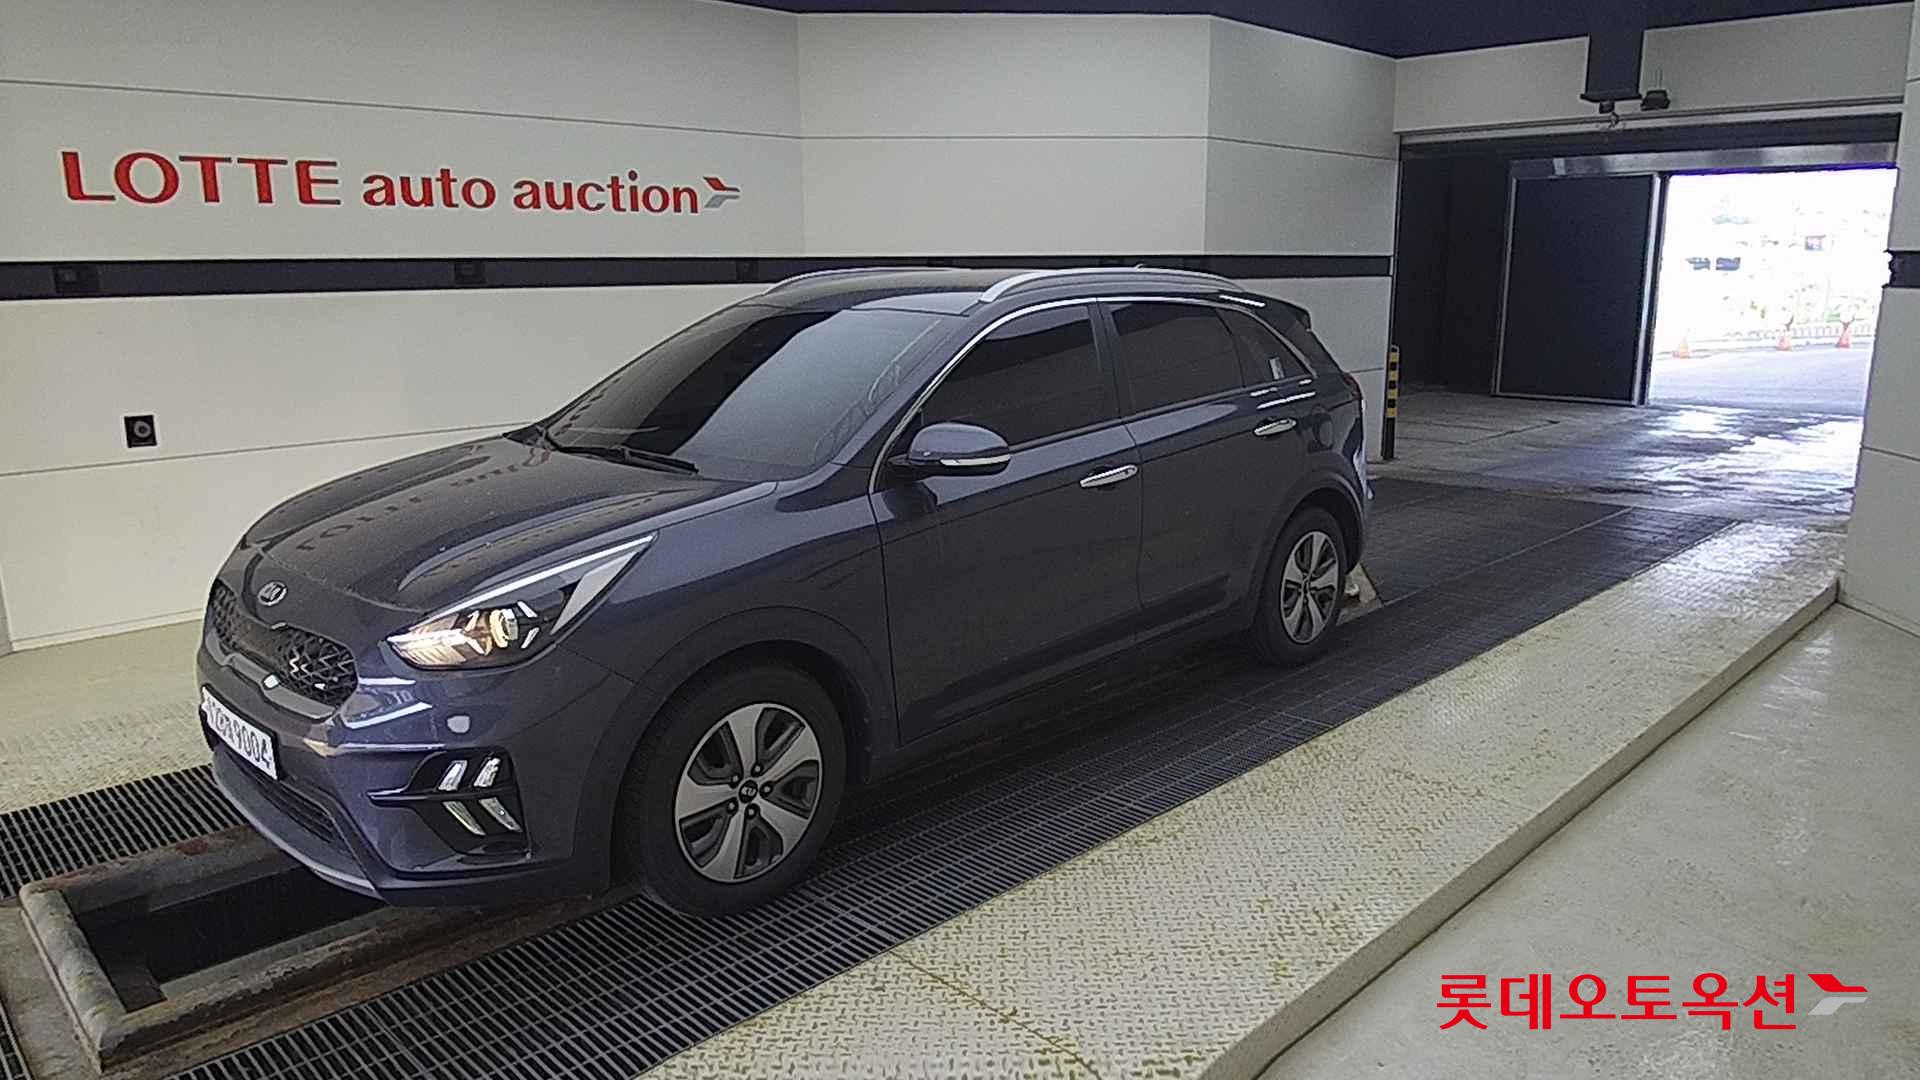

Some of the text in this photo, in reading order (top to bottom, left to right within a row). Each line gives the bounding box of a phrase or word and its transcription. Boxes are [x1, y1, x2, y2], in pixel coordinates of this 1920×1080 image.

[61, 151, 699, 214] LOTTE auto auction
